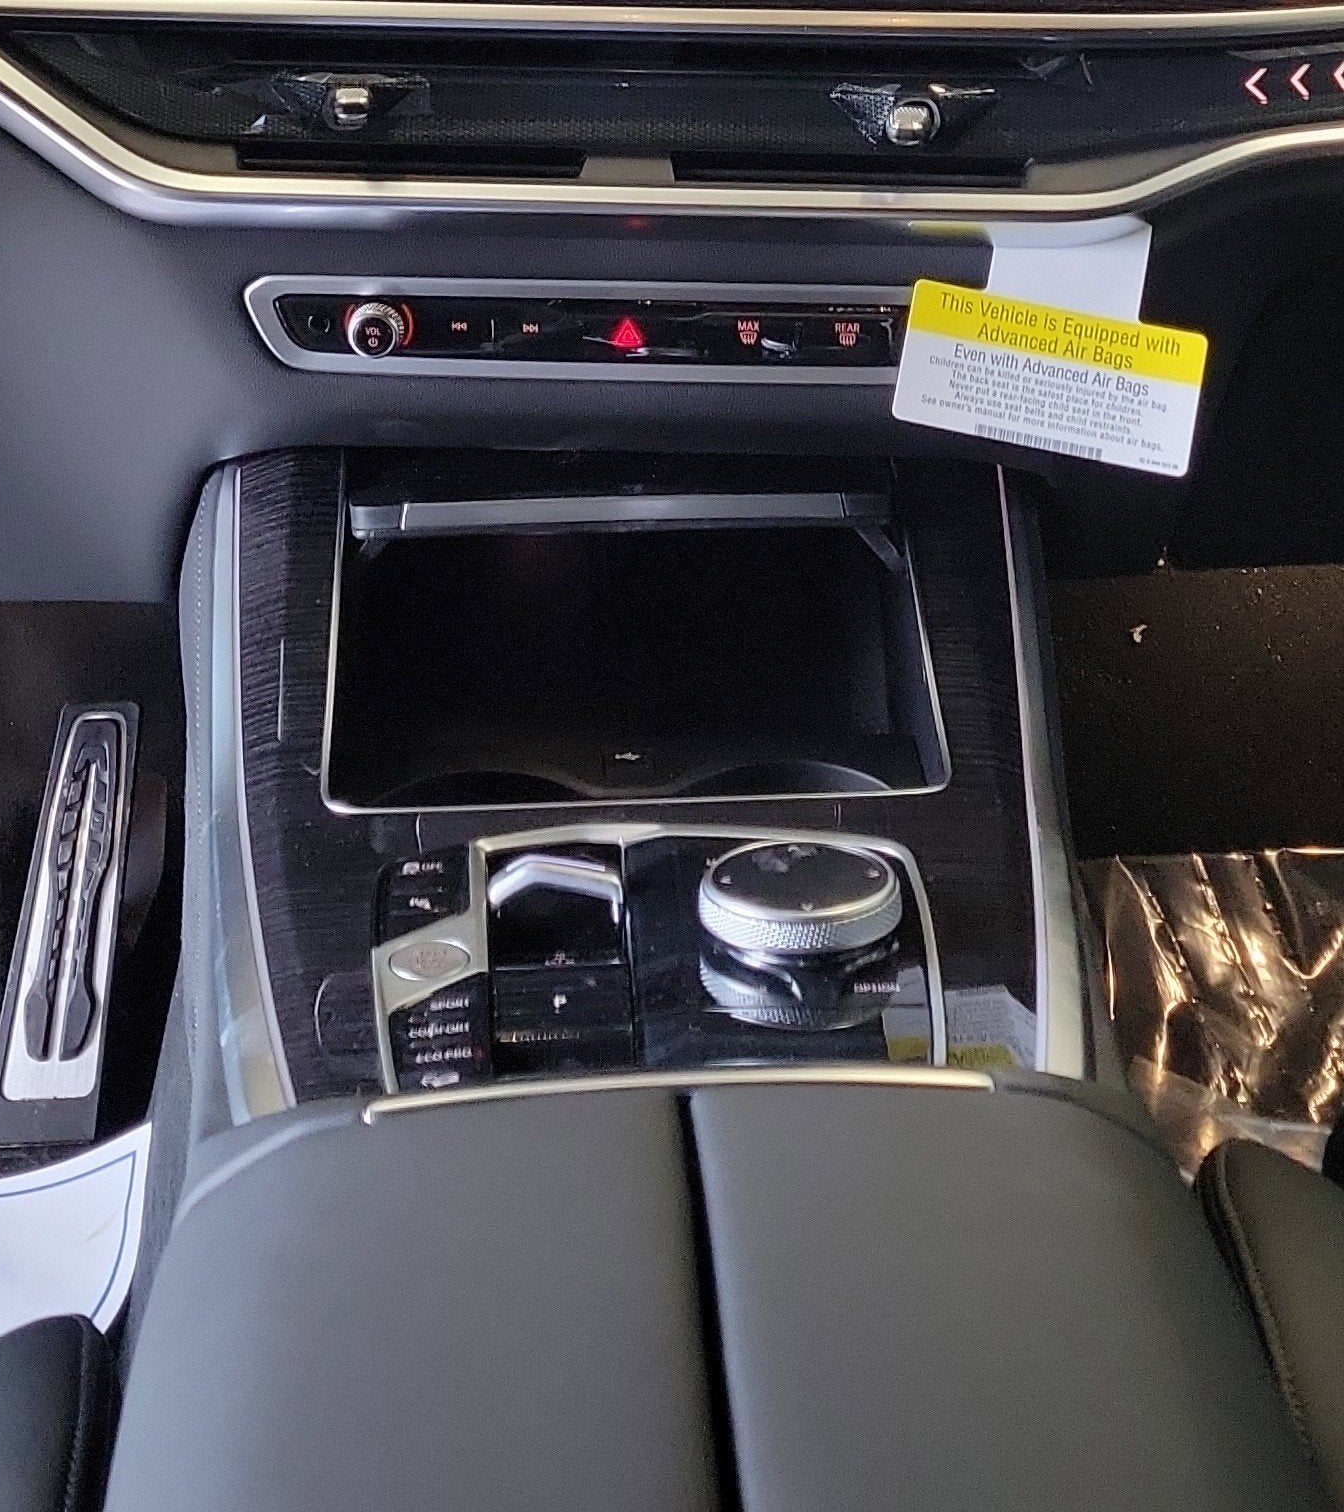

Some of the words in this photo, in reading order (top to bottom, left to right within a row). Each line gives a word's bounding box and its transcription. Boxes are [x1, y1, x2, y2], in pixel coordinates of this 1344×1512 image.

[365, 326, 382, 336] VOL
[737, 320, 760, 332] MAX
[834, 322, 860, 334] REAR
[940, 291, 974, 315] This
[979, 298, 1038, 328] Vehicle
[1043, 312, 1058, 332] is
[1062, 316, 1141, 348] Equipped
[1146, 336, 1181, 357] with
[977, 322, 1059, 355] Advanced
[1062, 339, 1088, 360] Air
[1092, 345, 1134, 371] Bags
[929, 355, 965, 370] Children
[967, 364, 982, 374] can
[984, 366, 995, 376] be
[997, 368, 1021, 382] killed
[1022, 374, 1033, 383] or
[1034, 377, 1073, 393] seriously
[1075, 386, 1106, 400] injured
[1108, 392, 1121, 403] by
[1121, 395, 1135, 406] the
[1137, 399, 1149, 408] air
[951, 369, 967, 381] The
[969, 374, 989, 386] back
[991, 379, 1010, 390] seat
[1011, 383, 1020, 392] is
[1021, 385, 1036, 395] the
[1037, 387, 1064, 401] safest
[1065, 394, 1089, 407] place
[1091, 398, 1104, 409] for
[953, 342, 987, 364] Even
[990, 352, 1019, 370] with
[1021, 357, 1089, 384] Advanced
[1091, 371, 1113, 389] Air
[1115, 375, 1150, 398] Bags
[920, 393, 937, 405] See
[938, 398, 972, 413] owner's
[974, 406, 1006, 420] manual
[1007, 411, 1021, 422] for
[1022, 416, 1045, 428] more
[1047, 418, 1097, 438] information
[1099, 430, 1125, 445] about
[1126, 435, 1139, 446] air
[948, 379, 974, 392] Never
[975, 386, 991, 397] put
[1048, 400, 1070, 412] child
[1071, 405, 1091, 417] seat
[1092, 409, 1101, 418] in
[1102, 411, 1117, 421] the
[954, 390, 985, 405] Always
[986, 399, 1002, 409] use
[1004, 401, 1023, 412] seat
[1024, 405, 1045, 417] belts
[1047, 409, 1064, 421] and
[1065, 413, 1088, 426] child
